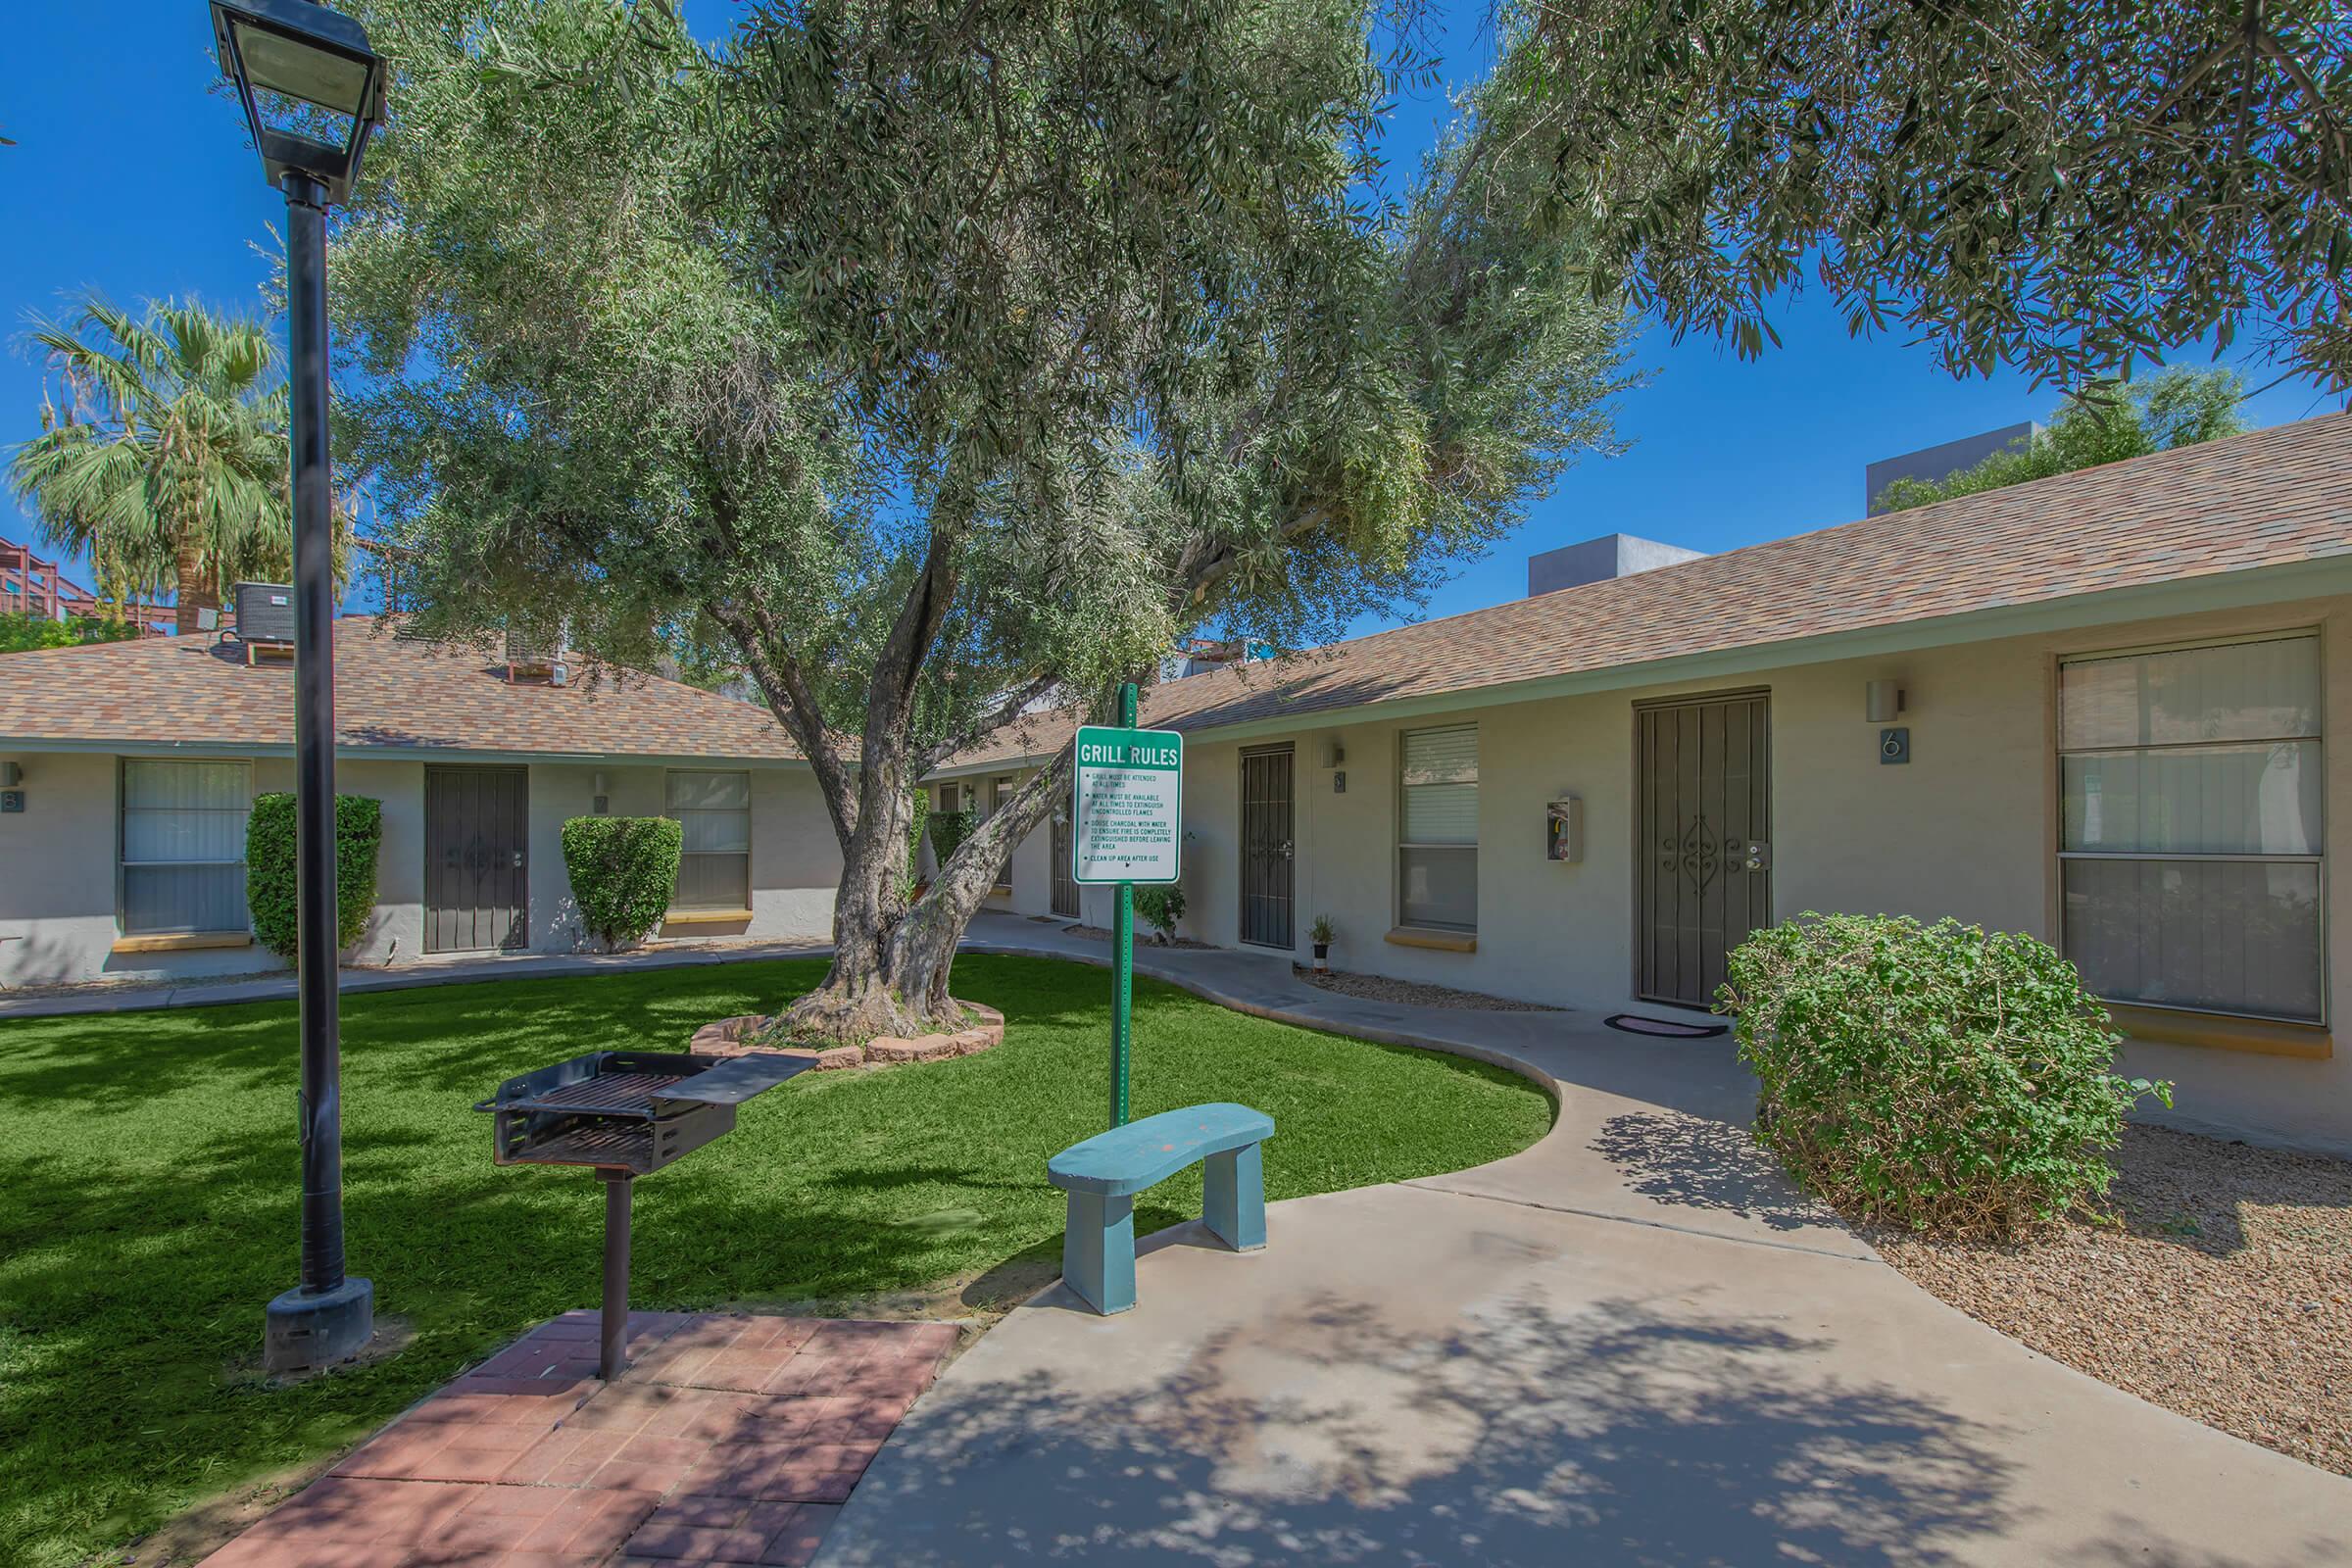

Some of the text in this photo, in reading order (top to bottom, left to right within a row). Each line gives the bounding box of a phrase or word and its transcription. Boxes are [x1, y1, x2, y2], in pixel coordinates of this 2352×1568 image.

[1081, 744, 1178, 766] GRILL RULES
[1883, 732, 1899, 756] 6
